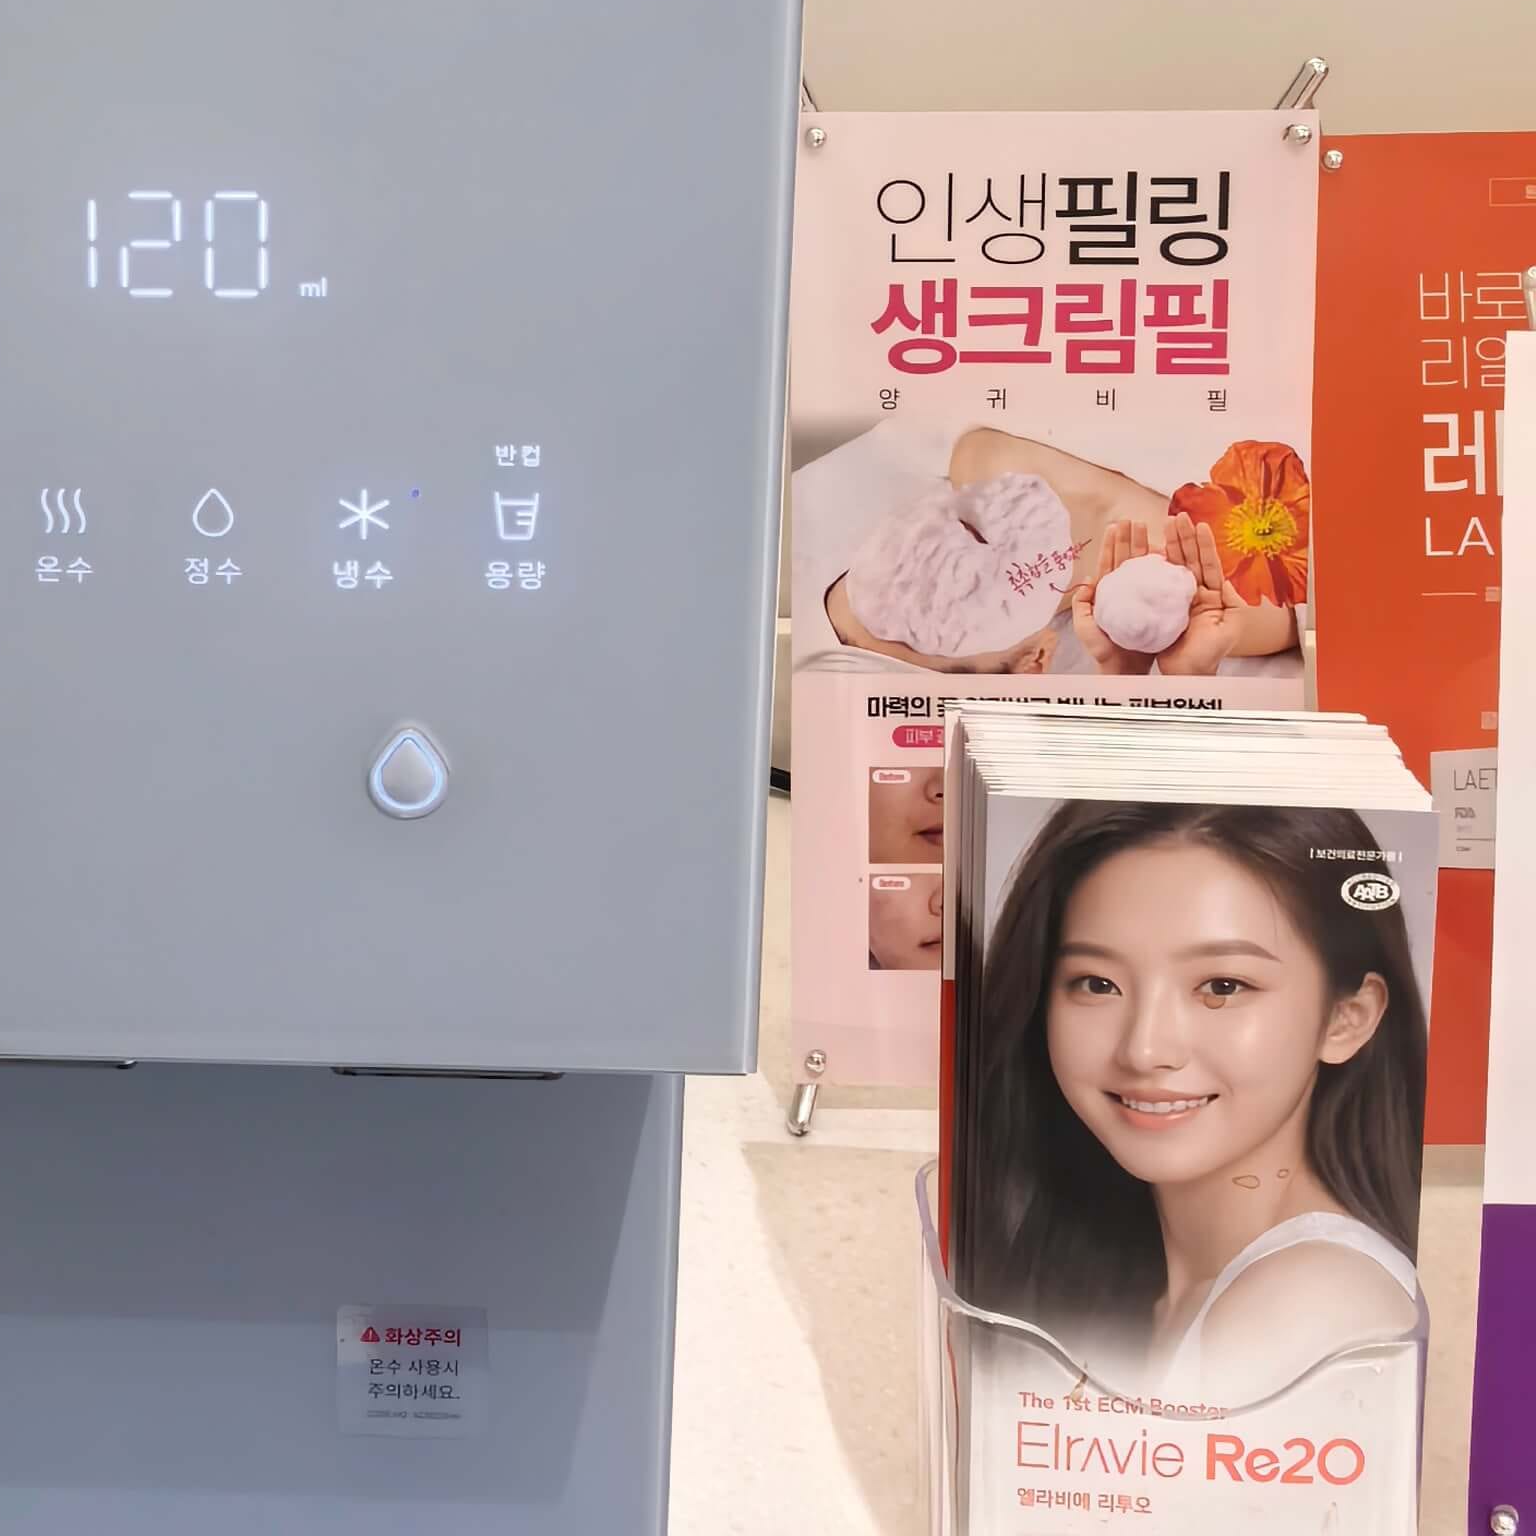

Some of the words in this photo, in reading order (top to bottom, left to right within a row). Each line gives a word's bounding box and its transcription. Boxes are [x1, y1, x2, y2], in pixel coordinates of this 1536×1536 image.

[876, 170, 1231, 266] 인생필링
[85, 189, 272, 300] 120
[298, 275, 328, 300] ml
[870, 277, 1231, 376] 생크림필
[494, 444, 541, 467] 반컵
[34, 555, 94, 584] 온수
[183, 556, 243, 586] 정수
[332, 559, 394, 590] 냉수
[484, 560, 546, 590] 용량
[867, 696, 931, 718] 마력의
[385, 1327, 461, 1347] 화상주의
[369, 1358, 401, 1376] 온수
[408, 1359, 459, 1376] 사용시
[368, 1382, 461, 1400] 주의하세요.
[1018, 1391, 1054, 1410] The
[1063, 1395, 1091, 1412] 1st
[1098, 1397, 1144, 1415] ECM
[1097, 1493, 1153, 1515] 리투오
